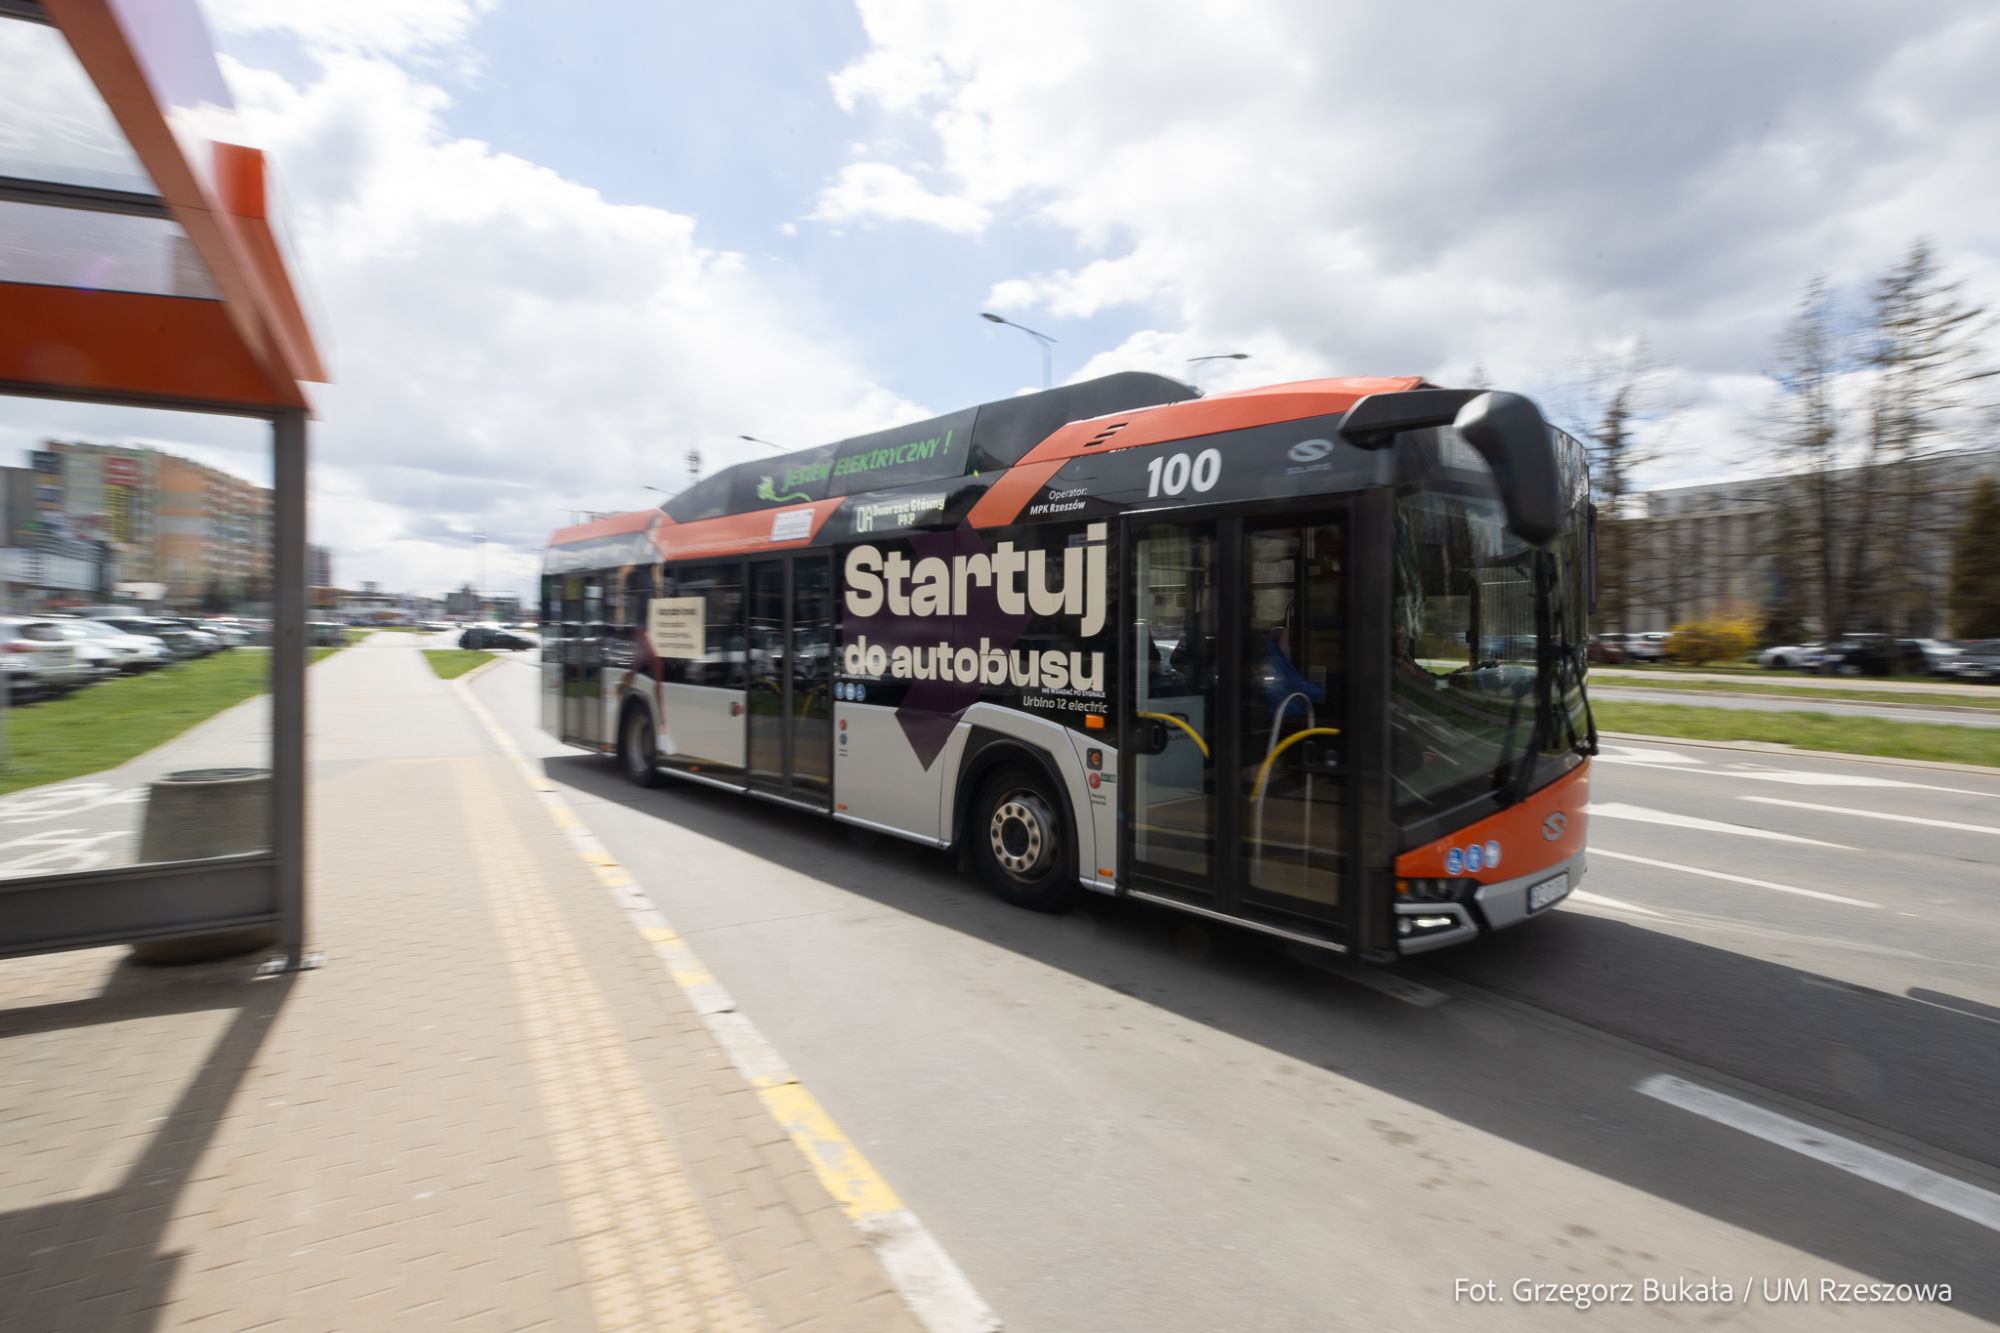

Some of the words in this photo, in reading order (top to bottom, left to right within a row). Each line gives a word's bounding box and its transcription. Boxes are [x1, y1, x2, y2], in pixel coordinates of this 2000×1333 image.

[833, 437, 941, 476] ELEKTRYCZNY
[1147, 448, 1222, 498] 100
[1030, 504, 1049, 515] MPK
[1049, 499, 1086, 513] Rzeszów
[1048, 488, 1088, 501] Operator:
[897, 512, 916, 526] PKP
[844, 523, 1107, 638] Startuj
[845, 635, 887, 677] do
[891, 637, 1105, 691] autobusu
[1023, 695, 1055, 709] Urbino
[1056, 698, 1067, 710] 12
[1068, 700, 1109, 714] electric
